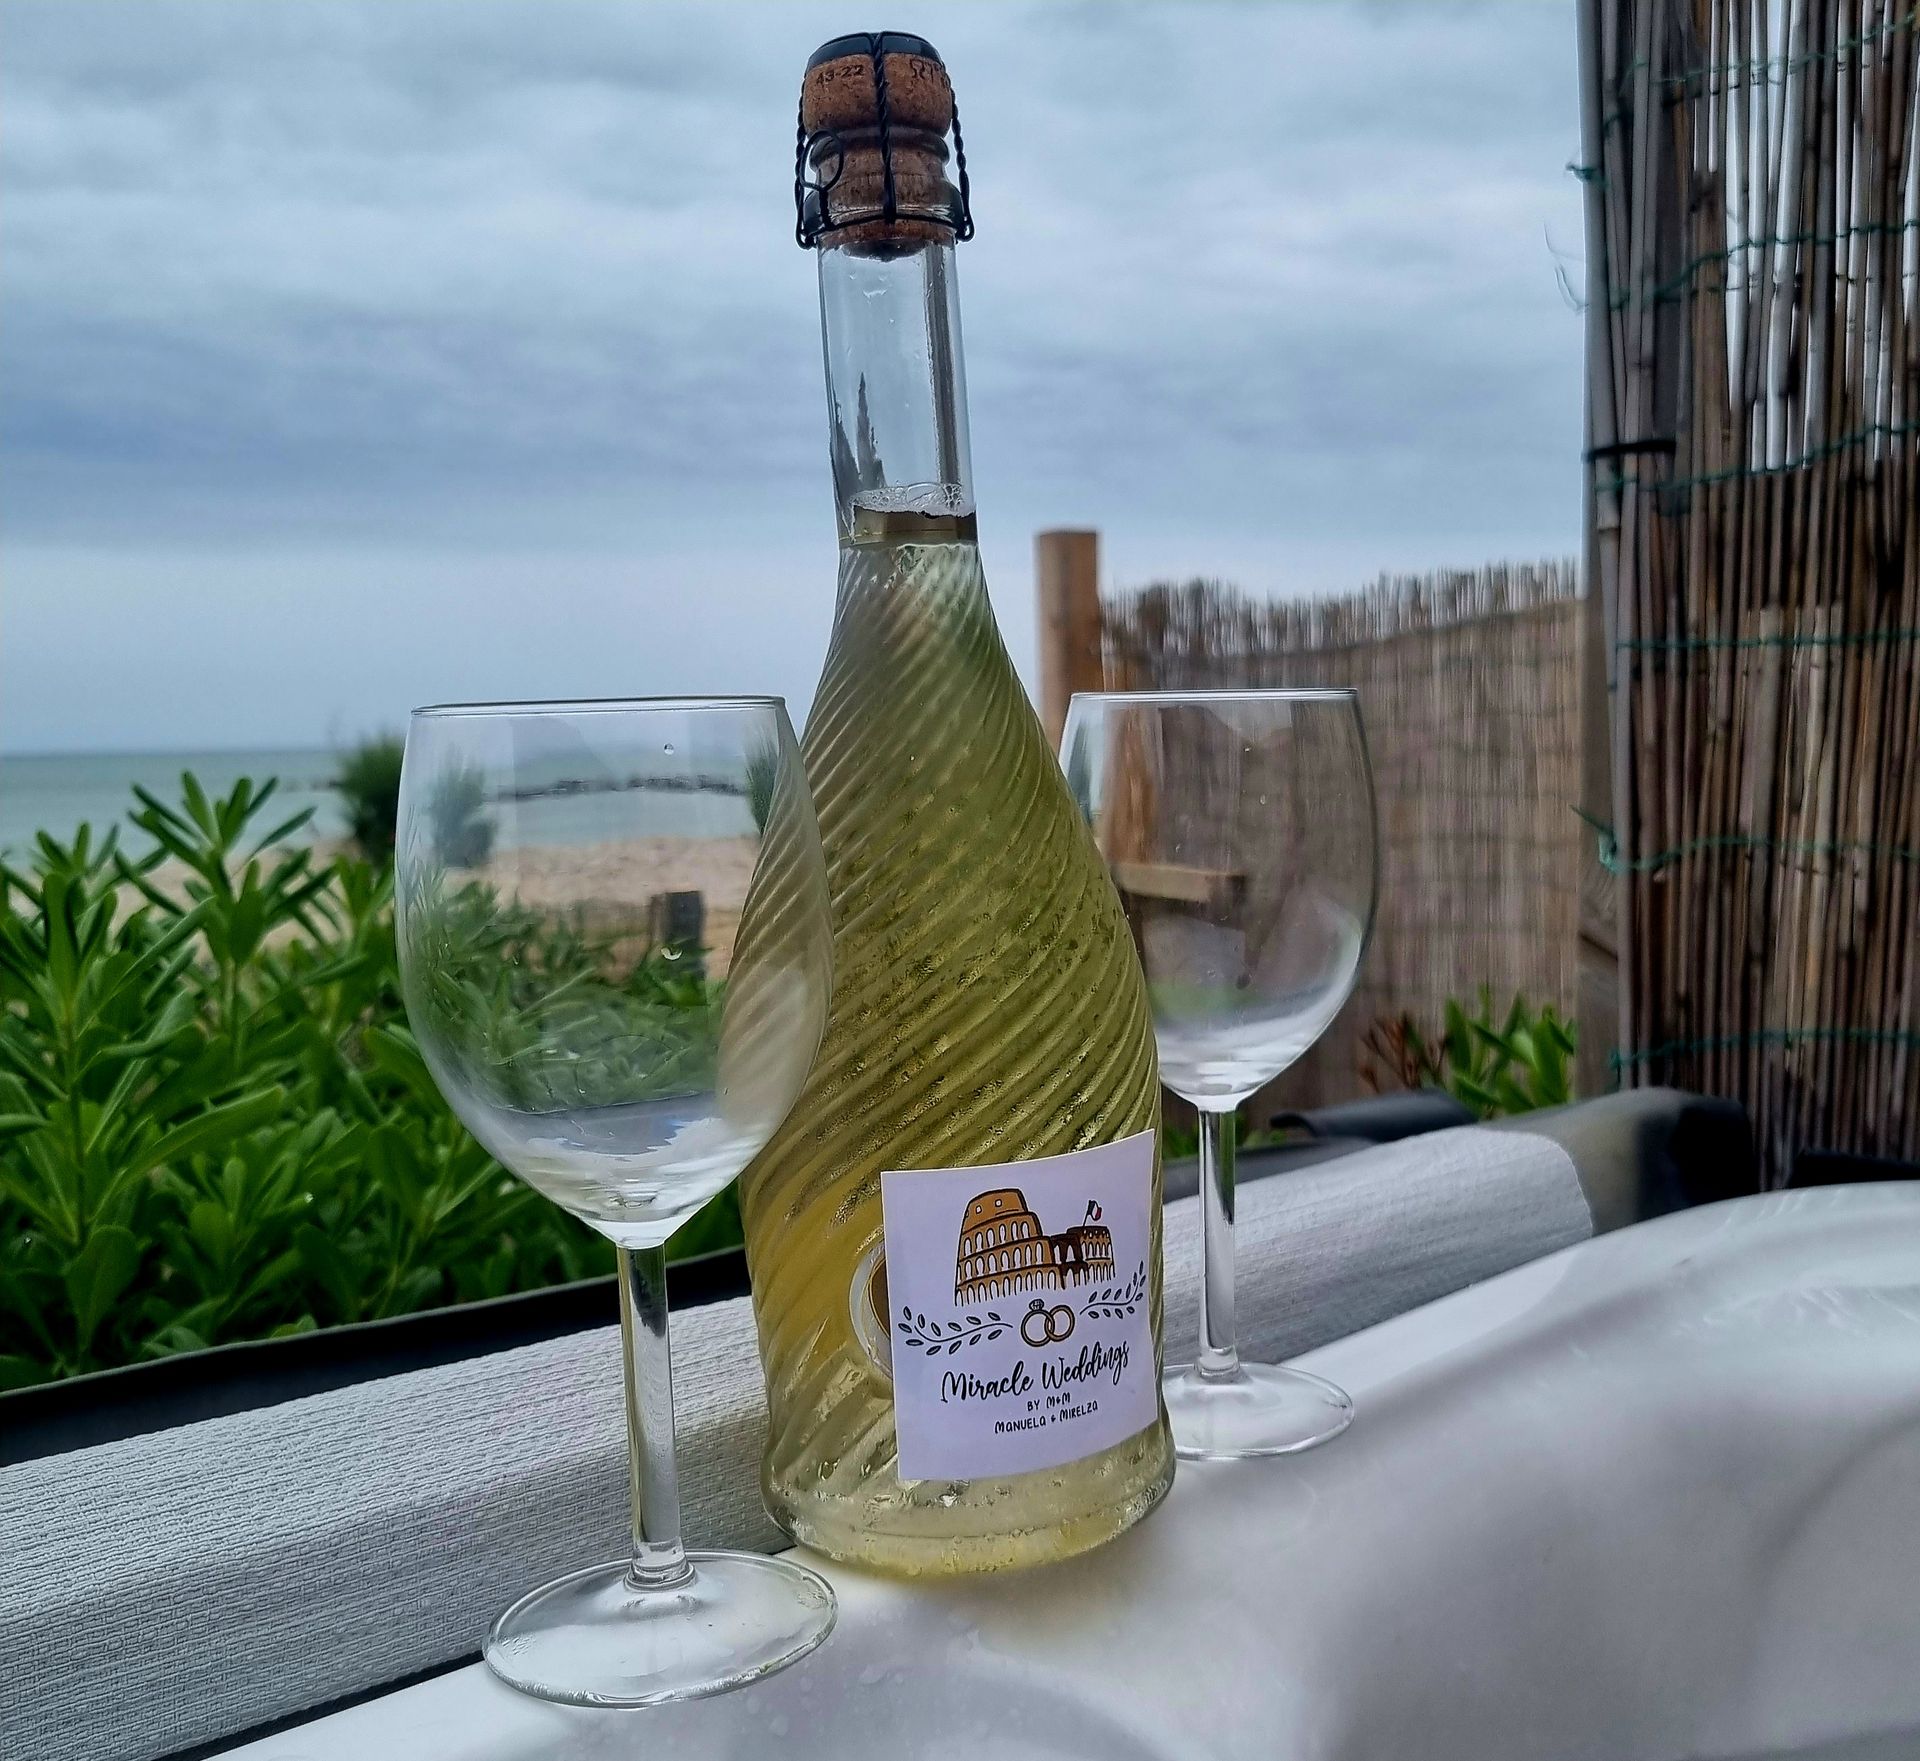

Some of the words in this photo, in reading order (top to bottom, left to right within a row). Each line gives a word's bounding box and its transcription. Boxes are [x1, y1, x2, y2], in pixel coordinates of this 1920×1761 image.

[941, 1360, 1034, 1402] Miracle
[1042, 1341, 1129, 1389] Weddings
[1027, 1400, 1040, 1411] BY
